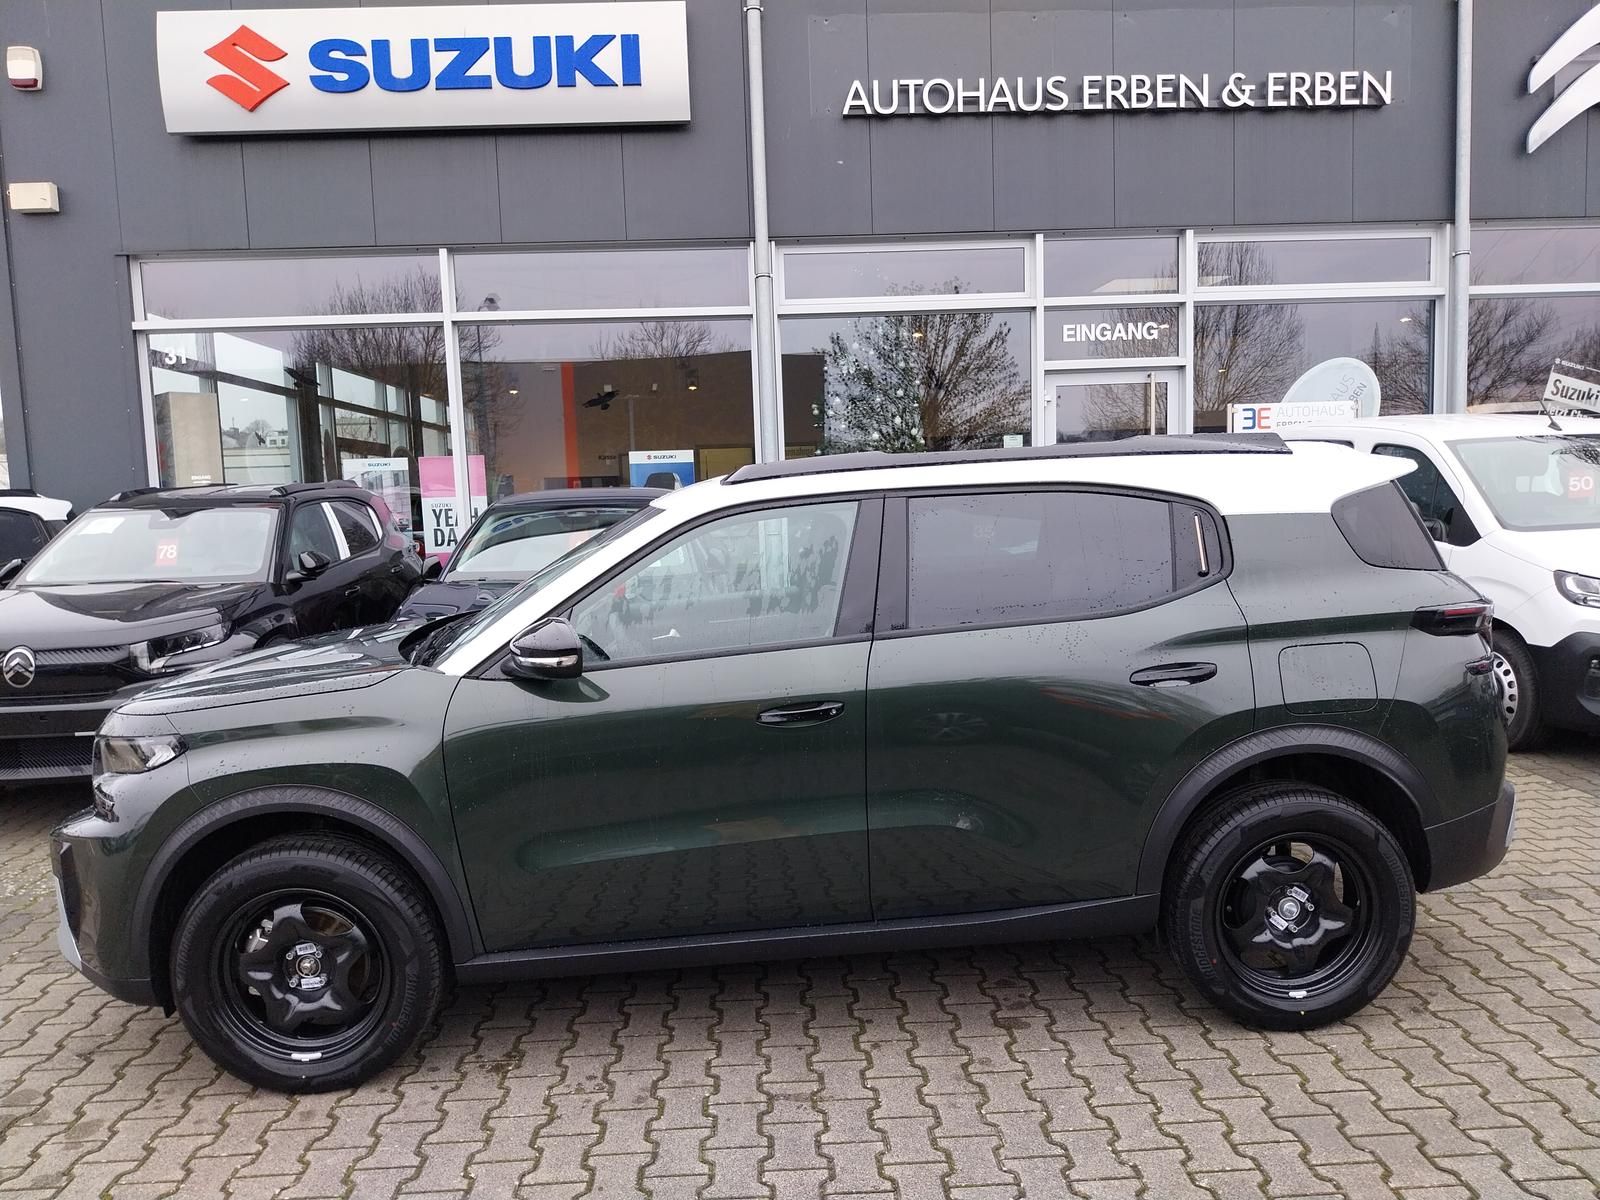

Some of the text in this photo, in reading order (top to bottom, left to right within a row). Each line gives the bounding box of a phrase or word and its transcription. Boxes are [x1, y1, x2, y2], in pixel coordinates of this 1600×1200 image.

[308, 34, 642, 93] SUZUKI
[842, 70, 1393, 115] AUTOHAUS ERBEN & ERBEN
[1062, 322, 1159, 342] EINGANG
[1276, 405, 1345, 418] AUTOHAUS
[1569, 476, 1594, 491] 50
[158, 544, 177, 559] 78
